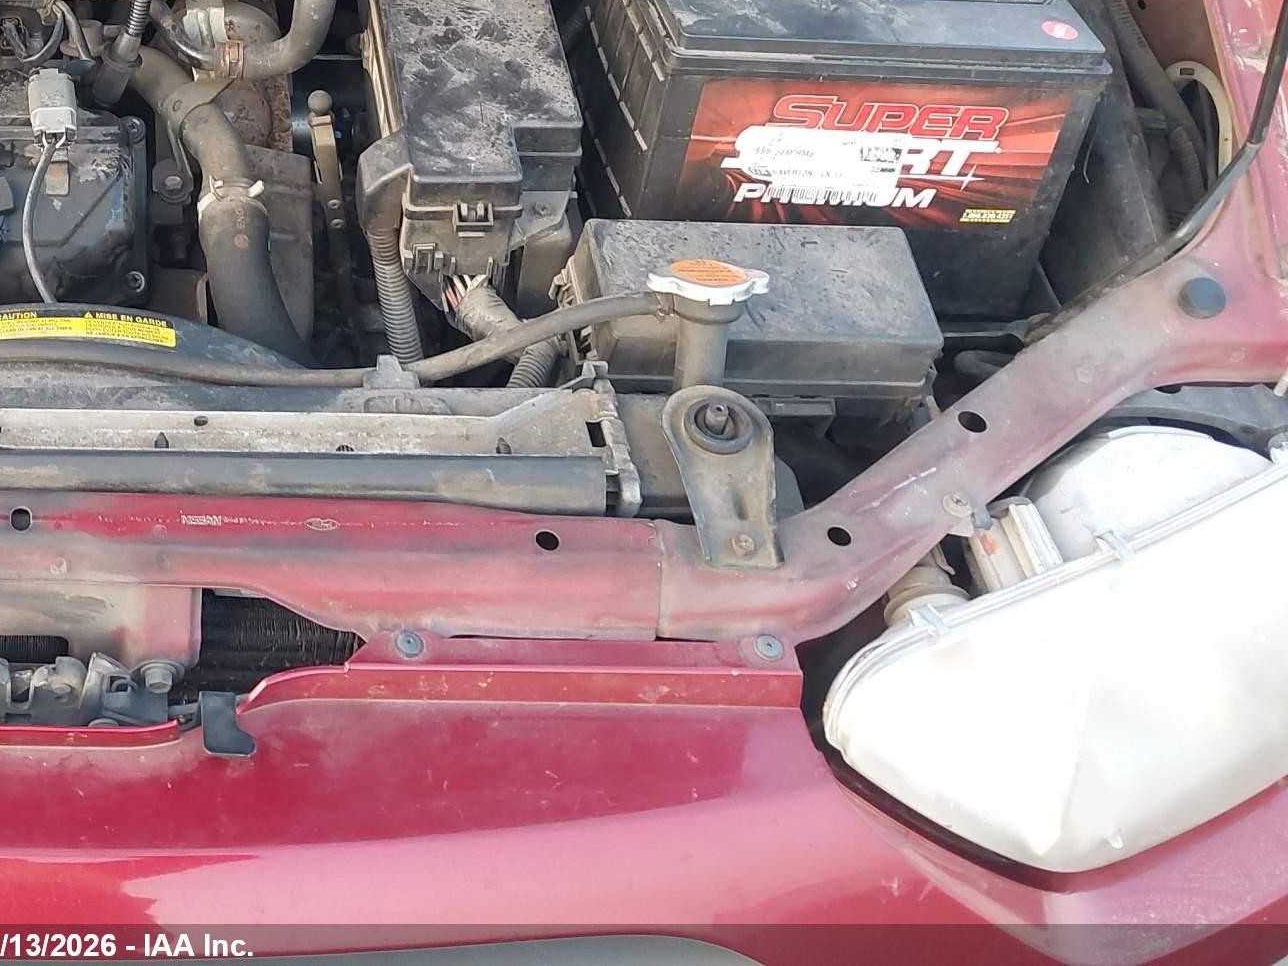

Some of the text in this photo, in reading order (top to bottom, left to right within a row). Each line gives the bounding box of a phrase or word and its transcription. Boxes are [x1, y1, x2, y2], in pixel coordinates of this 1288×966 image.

[769, 94, 1010, 140] SUPER
[95, 312, 167, 328] MISE EN GARDE
